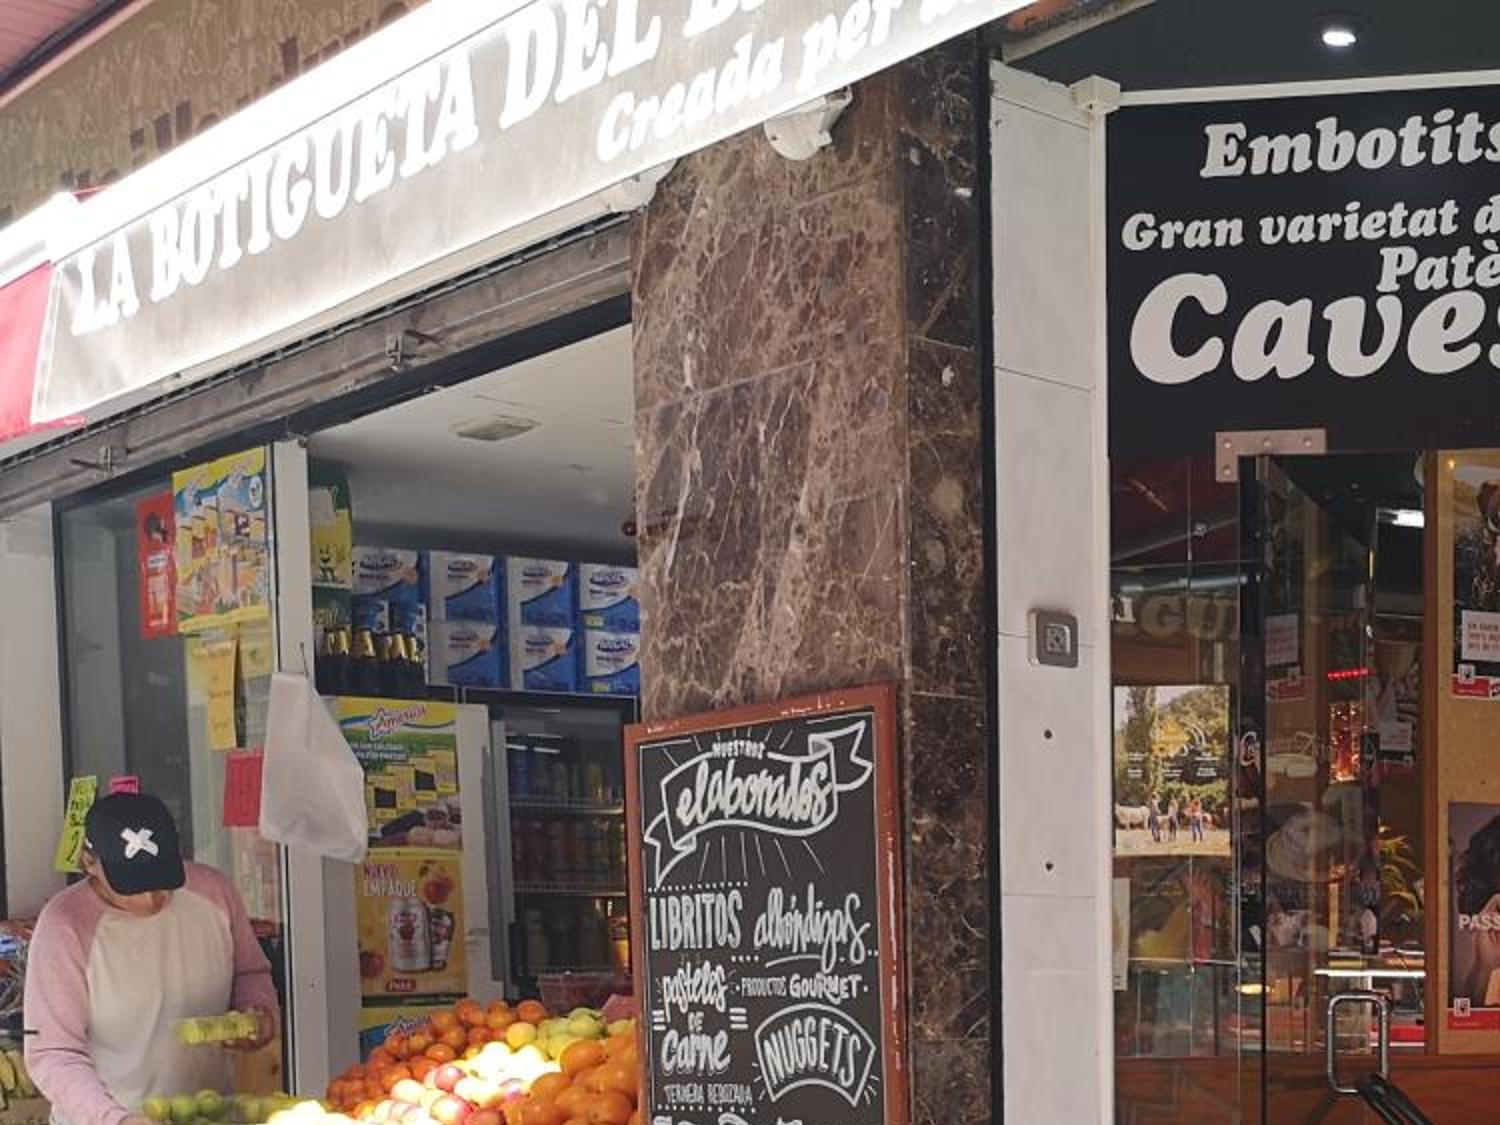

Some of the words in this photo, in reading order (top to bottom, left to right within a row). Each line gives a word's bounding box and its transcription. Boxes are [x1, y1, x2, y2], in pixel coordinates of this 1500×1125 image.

[598, 33, 785, 163] Creada
[801, 0, 901, 87] per
[70, 238, 141, 335] LA
[150, 62, 481, 304] BOTIGUETA
[498, 0, 662, 130] DEL
[1121, 213, 1243, 251] Gran
[1260, 202, 1457, 245] varietat
[676, 759, 832, 826] elaborados
[649, 889, 743, 951] LIBRITOS
[789, 973, 862, 1005] GOURMET
[661, 1029, 731, 1076] Carne
[763, 1016, 861, 1088] NUGGETS
